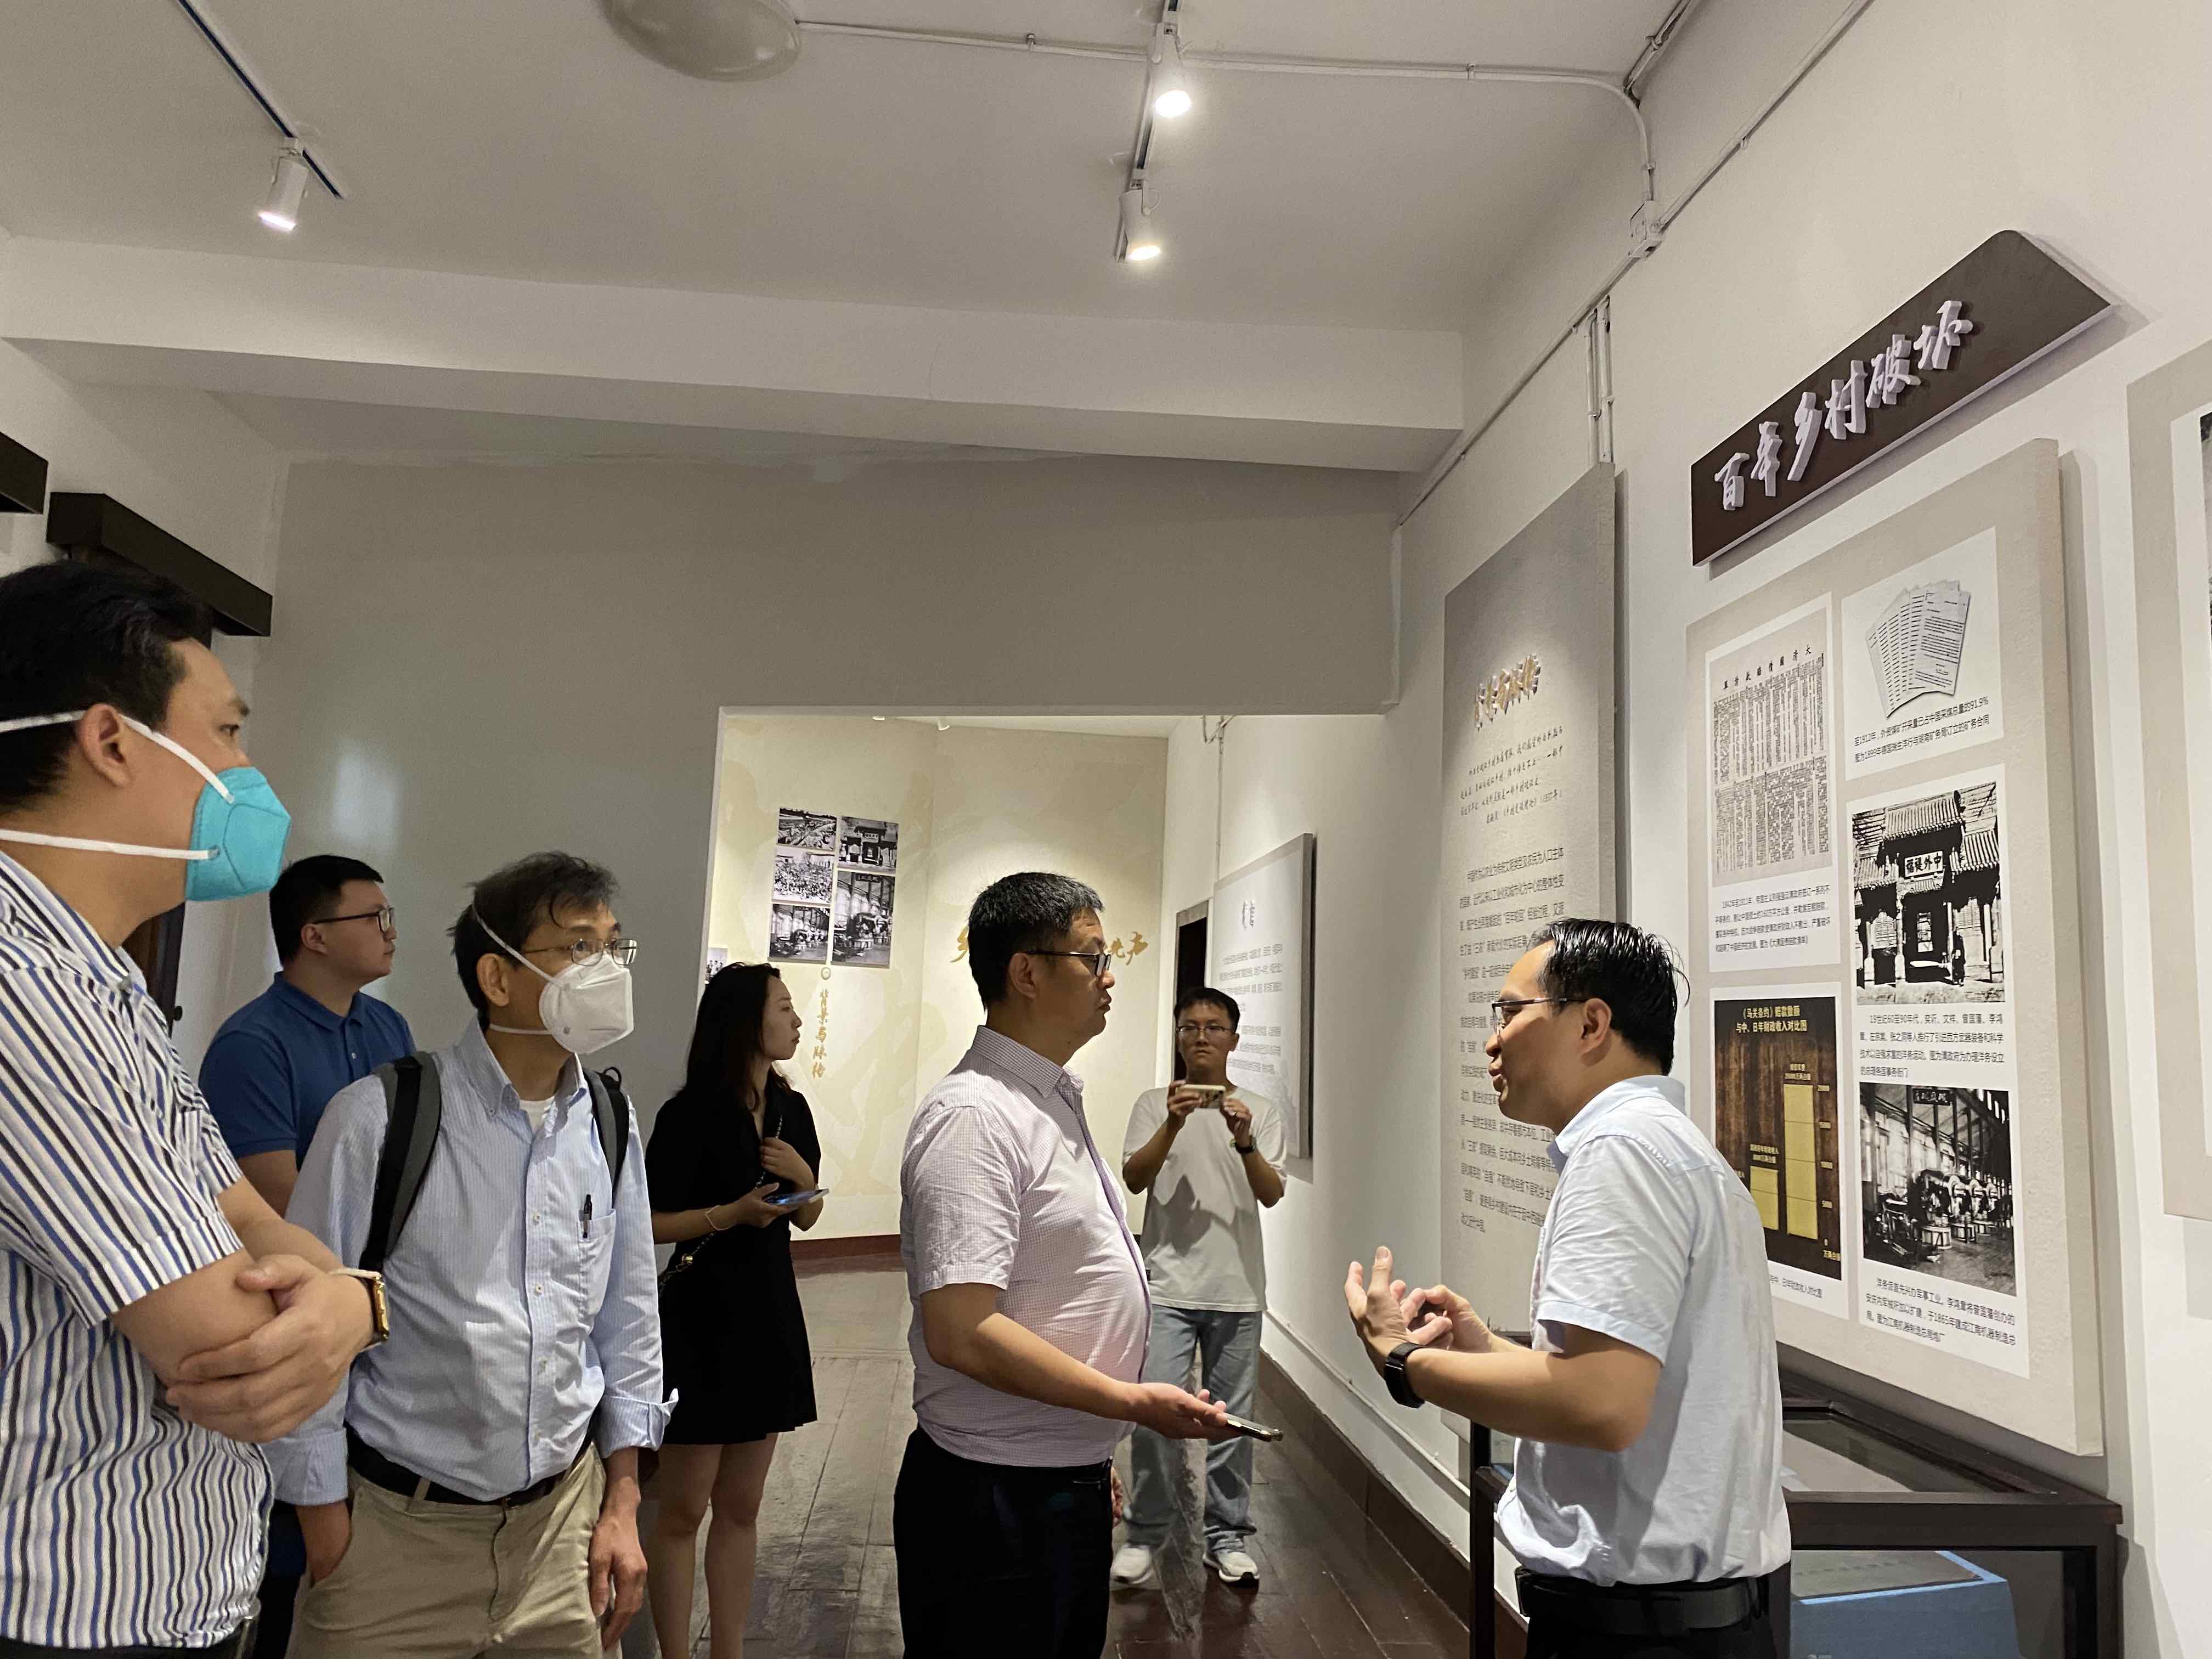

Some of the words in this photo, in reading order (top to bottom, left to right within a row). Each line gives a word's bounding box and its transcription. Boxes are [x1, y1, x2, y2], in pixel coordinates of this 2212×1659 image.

[1714, 300, 1974, 510] 百年乡村破坏
